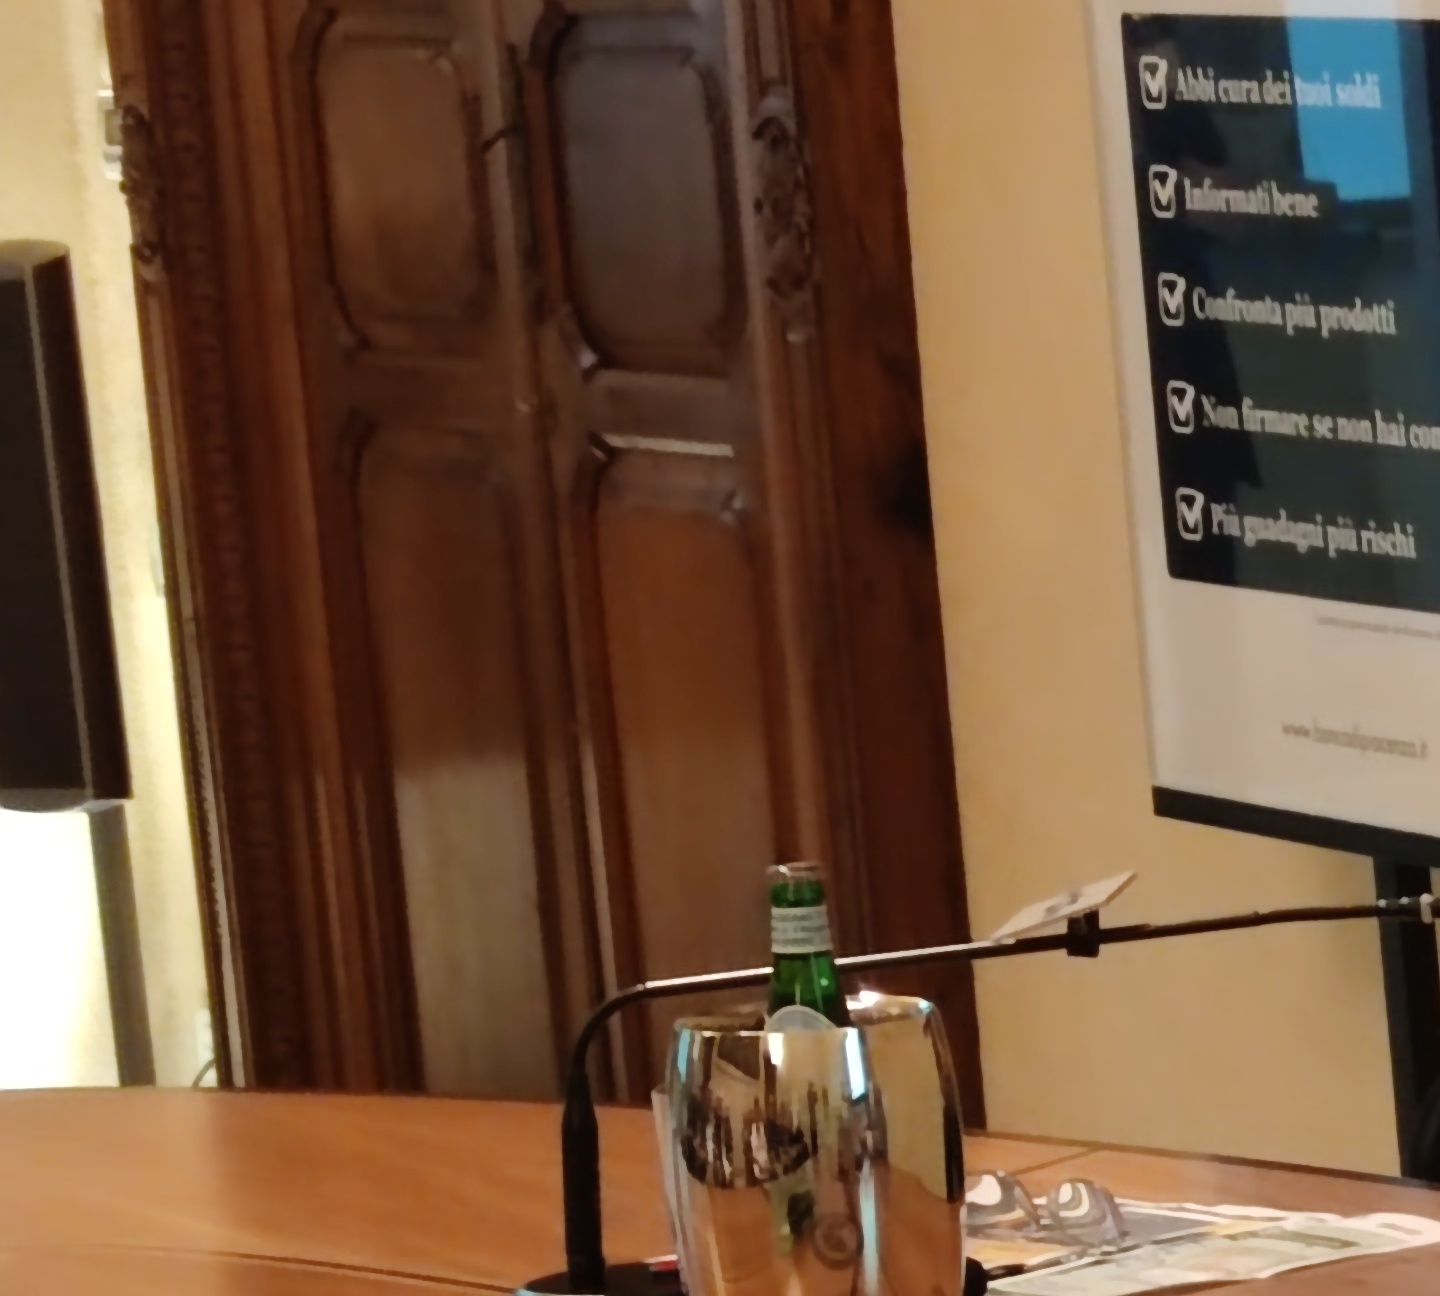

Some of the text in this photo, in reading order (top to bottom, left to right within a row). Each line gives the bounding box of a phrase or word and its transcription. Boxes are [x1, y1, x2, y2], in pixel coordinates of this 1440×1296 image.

[1175, 65, 1382, 108] Abbi cura dei tuoi soldi
[1184, 177, 1320, 217] Informati bene
[1193, 286, 1397, 339] Confronta più prodotti
[1201, 394, 1240, 430] Non
[1241, 396, 1309, 438] firmare
[1313, 413, 1333, 439] se
[1336, 417, 1373, 443] non
[1374, 409, 1407, 447] hai
[1210, 502, 1416, 558] Più guadagni più rischi
